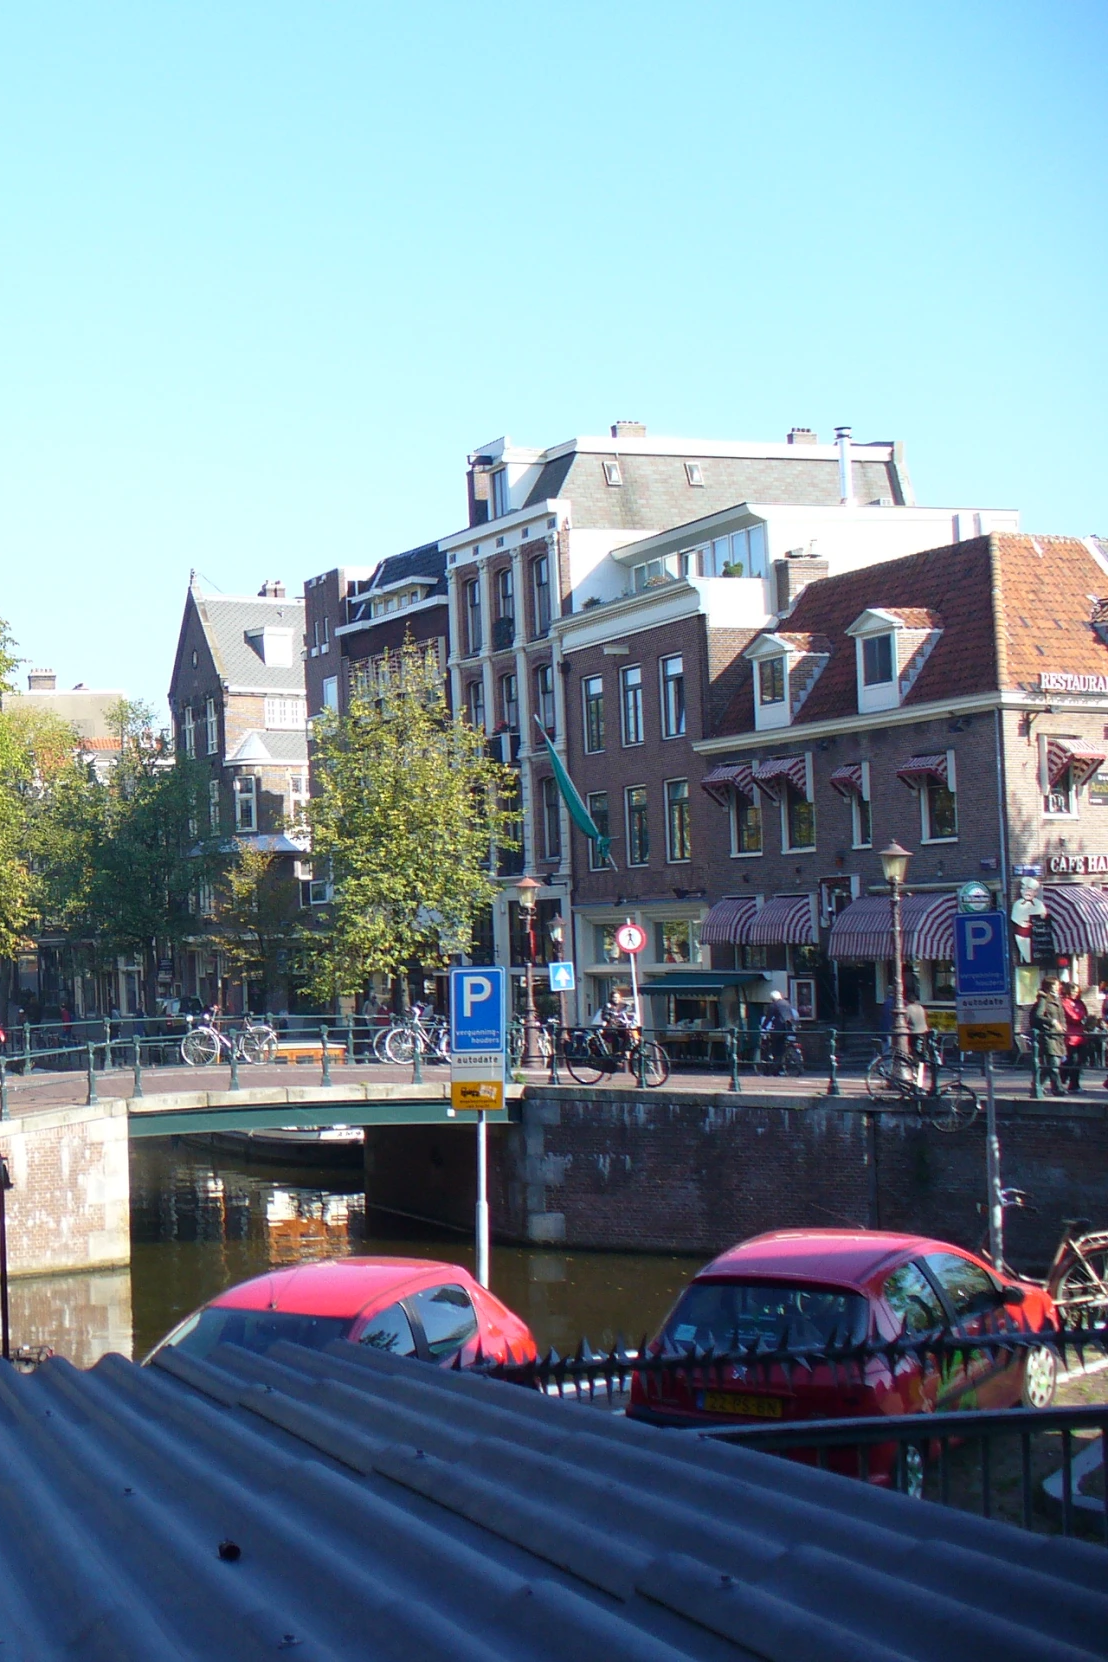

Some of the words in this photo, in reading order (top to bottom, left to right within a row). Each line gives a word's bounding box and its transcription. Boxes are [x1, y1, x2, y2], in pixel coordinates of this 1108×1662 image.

[1040, 672, 1108, 693] RESTAURA
[1088, 855, 1108, 873] HA
[964, 920, 992, 961] P
[463, 976, 492, 1017] P
[962, 998, 1004, 1007] autodate
[455, 1029, 500, 1038] vergunning-
[471, 1036, 500, 1044] houders
[457, 1056, 498, 1064] autodate
